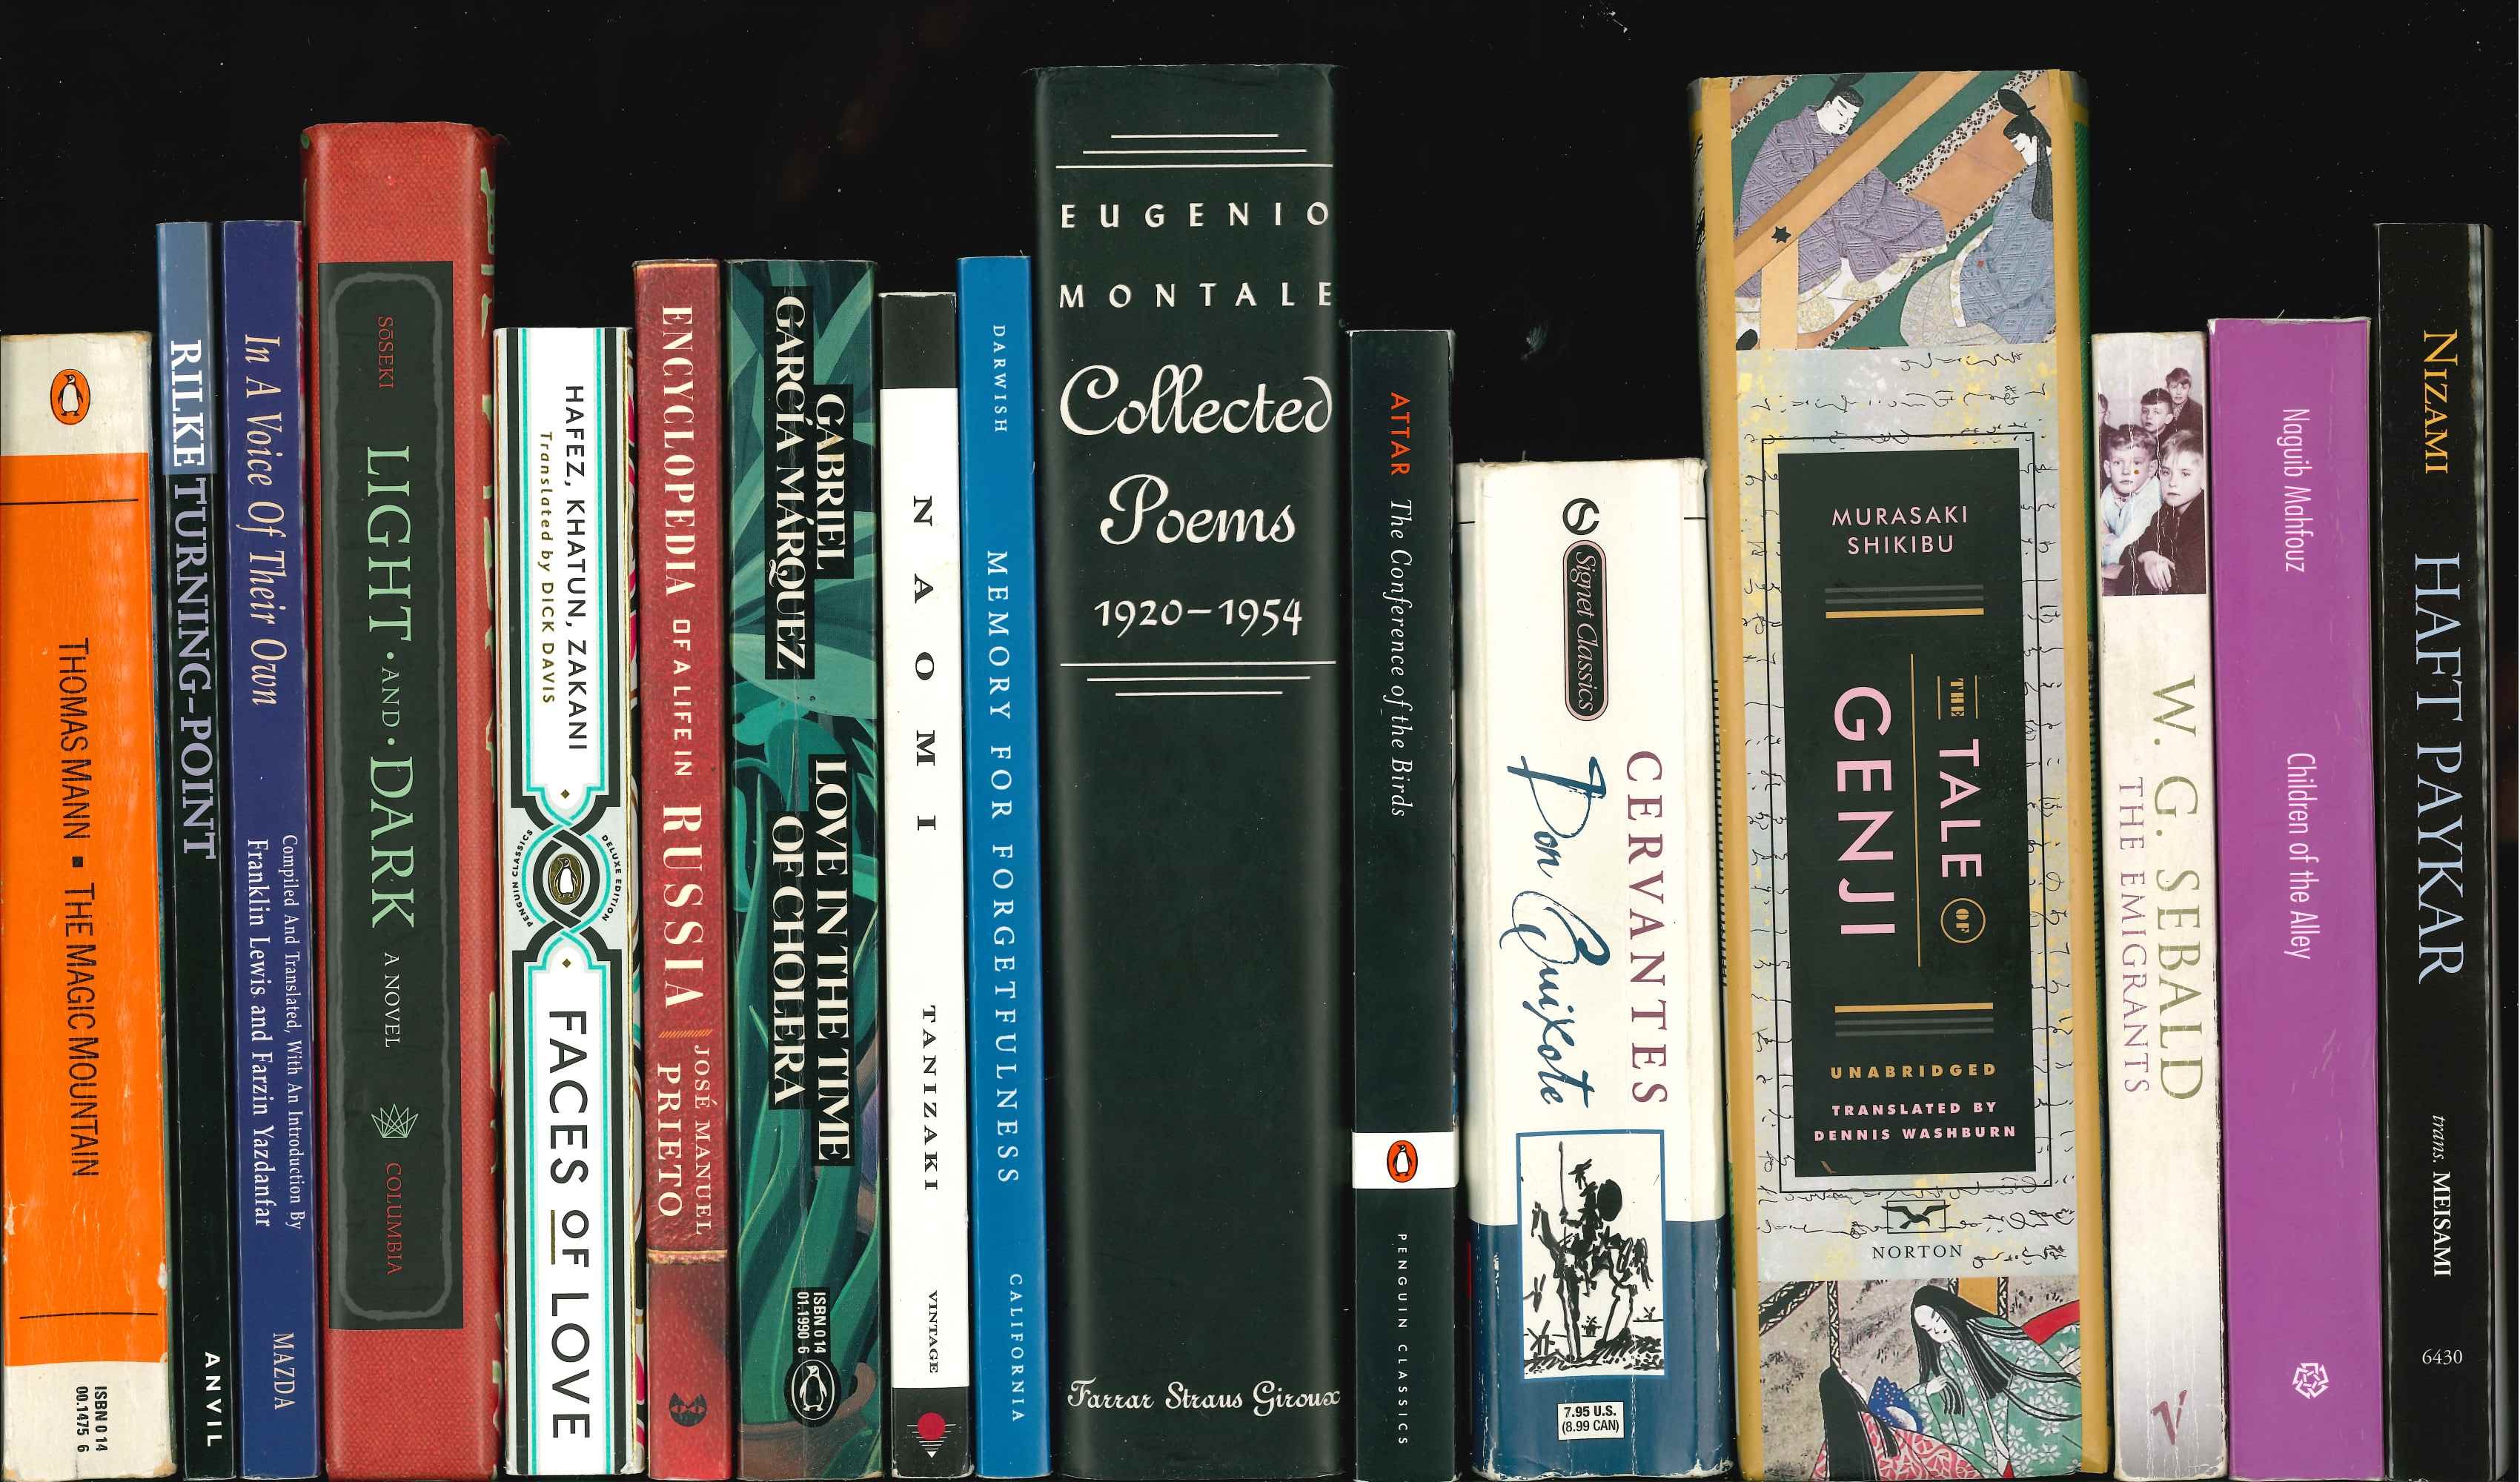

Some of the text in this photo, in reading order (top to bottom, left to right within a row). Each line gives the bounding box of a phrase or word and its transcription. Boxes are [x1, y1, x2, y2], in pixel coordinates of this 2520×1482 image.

[1062, 202, 1328, 227] EUGENIO
[1060, 282, 1331, 308] MONTALE
[993, 325, 1007, 431] DARWISH
[1060, 364, 1332, 435] Collected
[236, 334, 287, 705] In A Voice Of Their Own
[769, 296, 814, 669] GARCÍA MÁRQUEZ
[816, 394, 845, 569] GABRIEL
[1100, 474, 1295, 545] Poems
[1832, 506, 1966, 525] MURASAKI
[1848, 535, 1952, 554] SHIKIBU
[2277, 409, 2313, 572] Naguib Mahfouz
[171, 340, 217, 860] RILKE TURNING-POINT
[538, 432, 554, 702] Translated by DICK DAVIS
[565, 386, 587, 748] HAFEZ, KHATUN, ZAKANI
[1383, 393, 1413, 816] ATTAR The Conference of the Birds
[1570, 552, 1599, 711] Signet Classics
[2415, 553, 2463, 721] HAFT
[368, 446, 414, 928] LIGHT AND DARK
[663, 306, 703, 1008] ENCYCLOPEDIA OF A LIFE IN RUSSIA
[914, 496, 935, 831] NAOMI
[512, 830, 533, 927] PENGUIN CLASSICS
[602, 835, 621, 921] DELUXE EDITION
[988, 551, 1018, 1181] MEMORY FOR FORGETFULNESS
[1834, 687, 1895, 934] GENJI
[1940, 678, 1982, 933] THE TALE OF
[2284, 754, 2320, 959] Children of the Alley
[2417, 742, 2464, 984] PAYKAR
[59, 638, 99, 1175] THOMAS MANN THE MAGIC MOUNTAIN
[772, 816, 806, 1104] OF CHOLERA
[816, 760, 849, 1160] LOVE IN THE TIME
[1499, 756, 1610, 1108] Don Quixote
[1627, 751, 1668, 1102] CERVANTES
[2119, 777, 2149, 1091] THE EMIGRANTS
[2152, 674, 2203, 1099] W. G. SEBALD
[248, 840, 276, 1226] Franklin Lewis and Farzin Yazdanfar
[279, 835, 305, 1229] Compiled And Translated, With An Introduction By
[385, 952, 399, 1047] A NOVEL
[1831, 1064, 1995, 1079] UNABRIDGED
[657, 1063, 682, 1216] PRIETO
[694, 1045, 712, 1235] JOSÉ MANUEL
[923, 1006, 938, 1190] TANIZAKI
[1814, 1126, 2015, 1141] DENNIS WASHBURN
[1832, 1102, 1996, 1116] TRANSLATED BY
[386, 1163, 402, 1275] COLUMBIA
[549, 1011, 590, 1438] FACES OF LOVE
[1872, 1245, 1962, 1258] NORTON
[2433, 1115, 2451, 1277] trans. MEISAMI
[273, 1333, 295, 1409] MAZDA
[798, 1292, 809, 1338] 01.1990
[814, 1292, 826, 1325] ISBN
[815, 1340, 826, 1353] 14
[929, 1290, 938, 1372] VINTAGE
[1010, 1275, 1024, 1421] CALIFORNIA
[1398, 1235, 1407, 1443] PENGUIN CLASSICS
[2422, 1349, 2462, 1365] 6430
[76, 1386, 89, 1435] 00.1475
[95, 1386, 107, 1420] ISBN
[96, 1437, 107, 1451] 14
[205, 1352, 222, 1446] ANVIL
[1067, 1377, 1340, 1416] Farrar Straus Giroux
[1562, 1420, 1619, 1435] (8.99 CAN)
[1565, 1406, 1616, 1418] 7.95 U.S.
